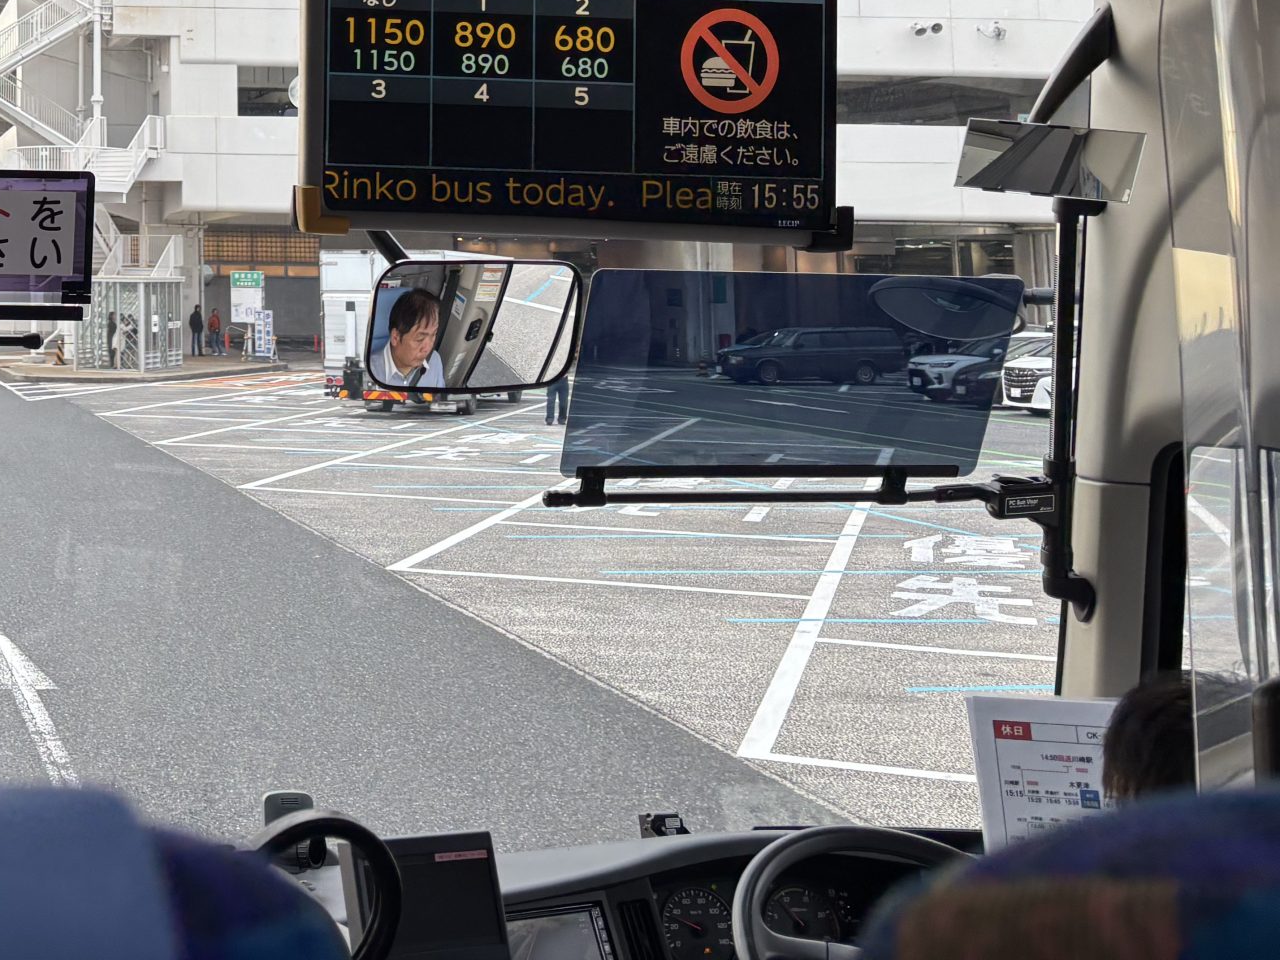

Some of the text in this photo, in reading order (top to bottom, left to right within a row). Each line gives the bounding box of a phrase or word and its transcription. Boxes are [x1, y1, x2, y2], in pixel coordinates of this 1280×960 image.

[345, 16, 425, 46] 1150
[454, 21, 516, 49] 890
[554, 25, 615, 53] 680
[353, 49, 415, 72] 1150
[461, 53, 509, 75] 890
[561, 57, 608, 78] 680
[371, 79, 386, 99] 3
[474, 83, 490, 102] 4
[574, 87, 589, 105] 5
[662, 117, 799, 140] 車内での飲食は、
[663, 143, 800, 166] ご遠慮ください。
[324, 170, 712, 212] Rinko bus today. Plea
[716, 181, 742, 195] 現在
[752, 184, 819, 209] 15:55
[716, 195, 742, 210] 時刻
[1001, 724, 1023, 736] 休日
